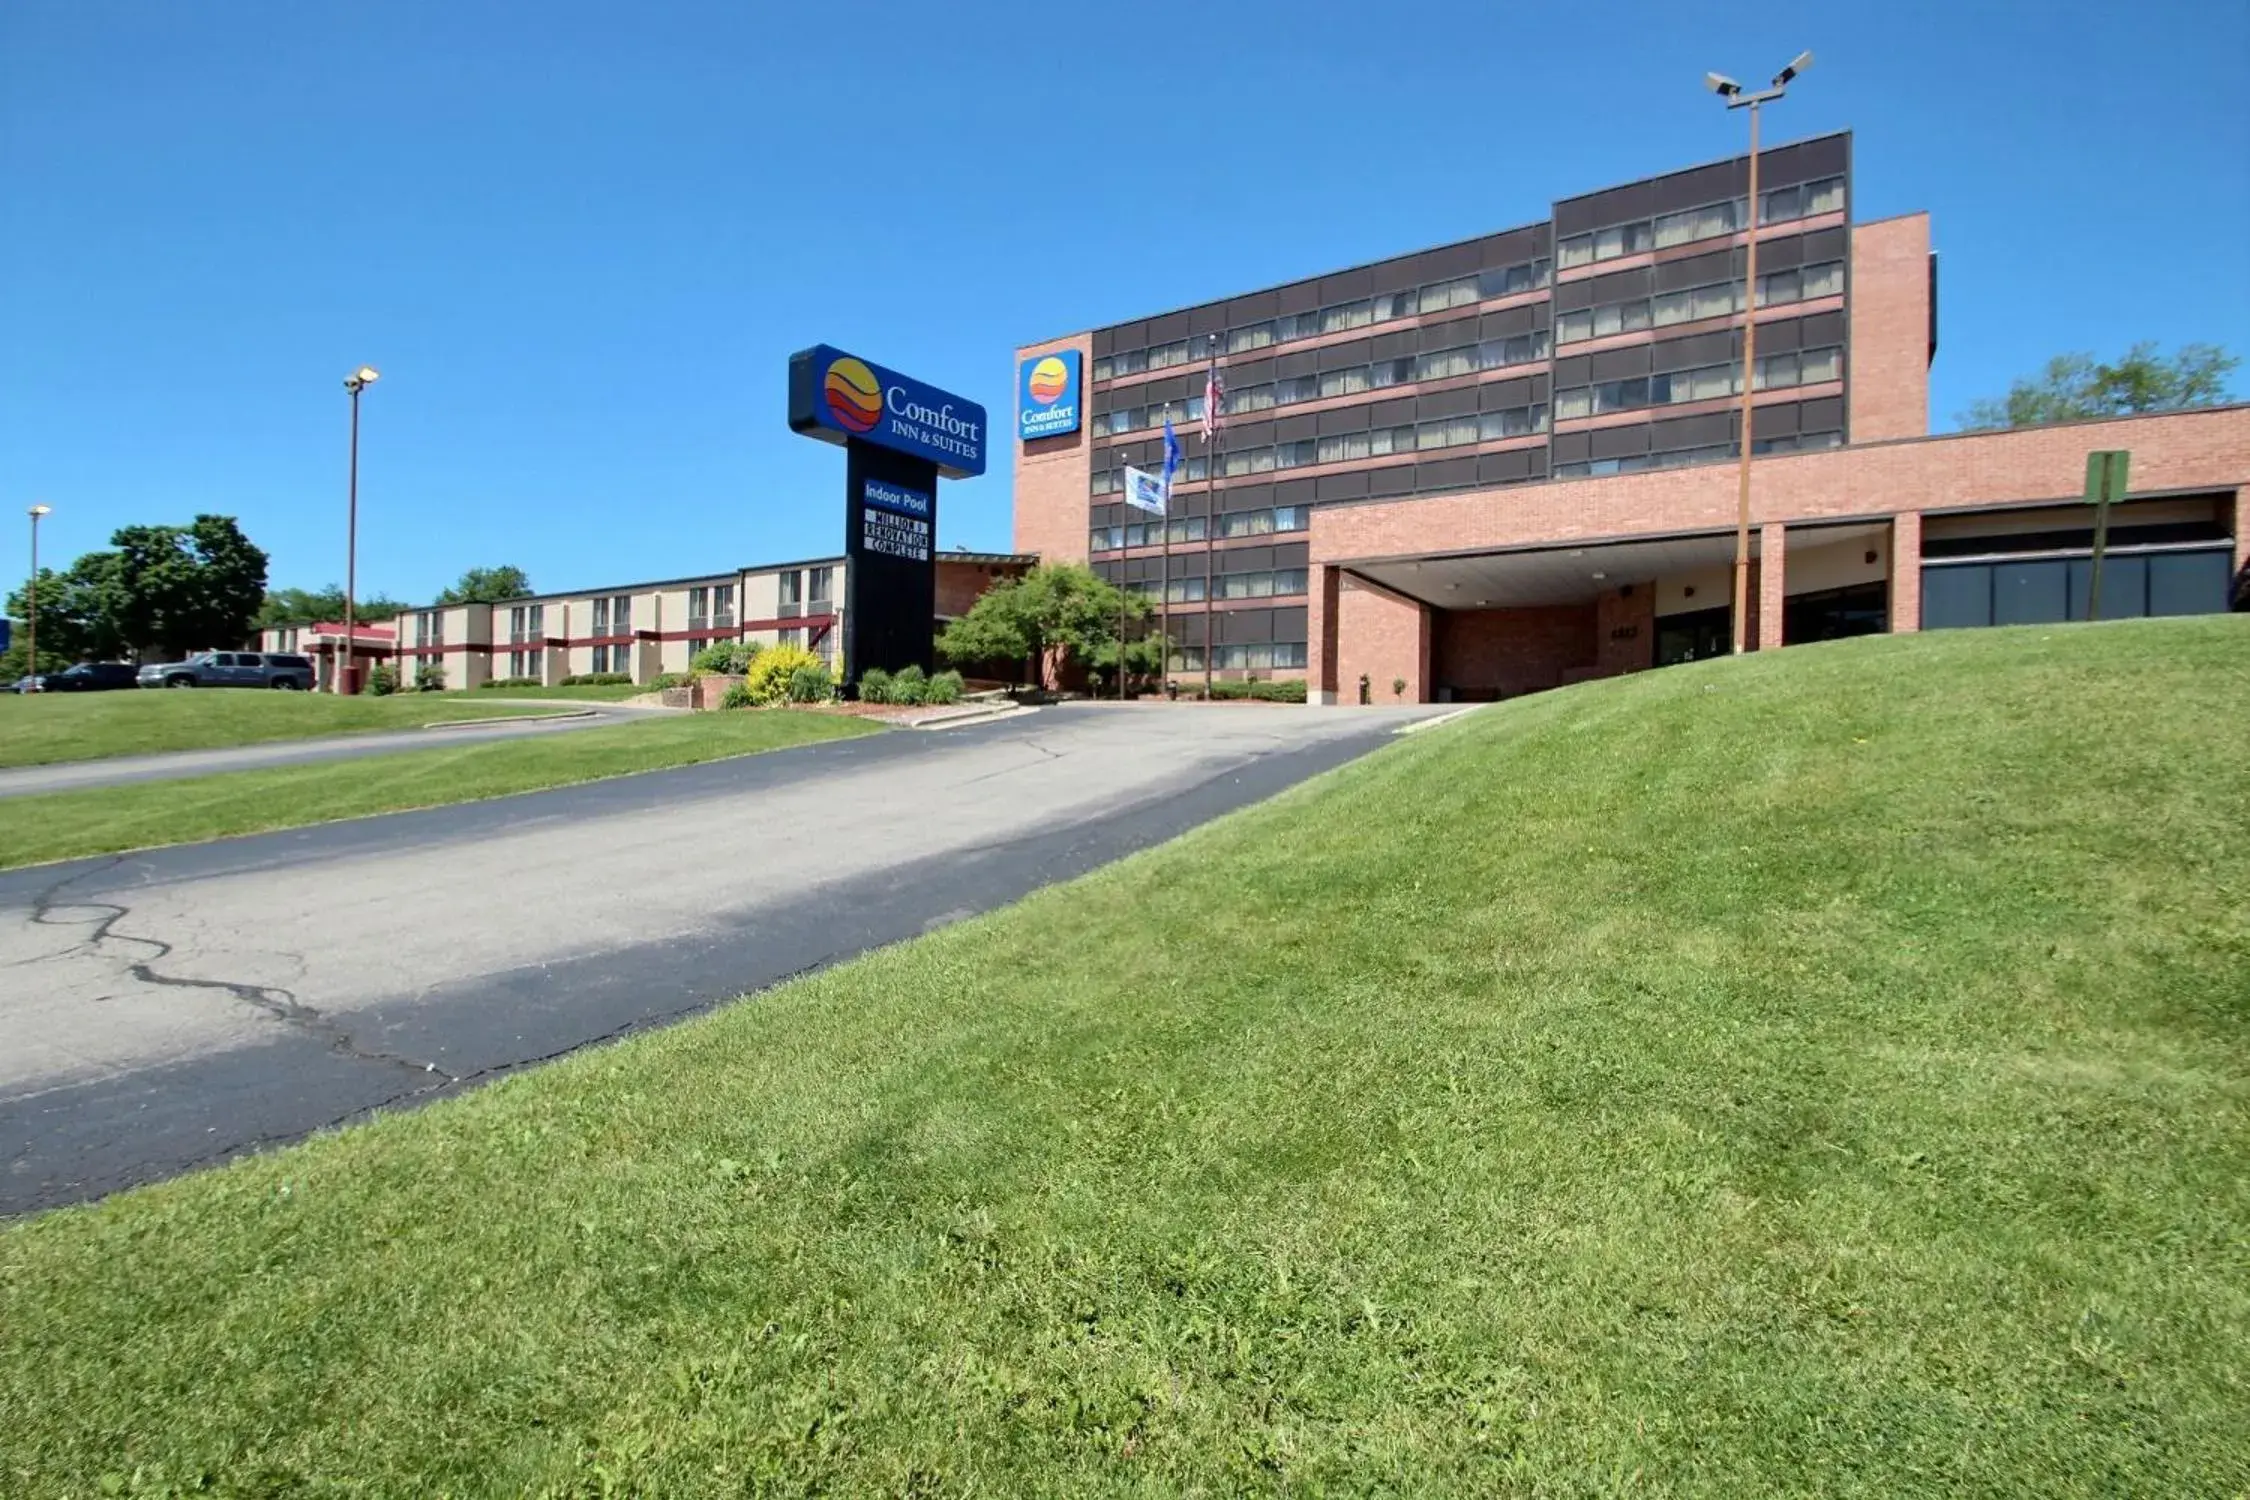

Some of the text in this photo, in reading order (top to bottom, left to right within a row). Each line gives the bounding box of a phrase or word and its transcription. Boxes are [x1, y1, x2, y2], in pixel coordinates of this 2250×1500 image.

[886, 386, 979, 442] Comfort
[1021, 403, 1073, 425] Comfort
[891, 420, 977, 459] INN & SUITES
[866, 484, 926, 512] Indoor Pool
